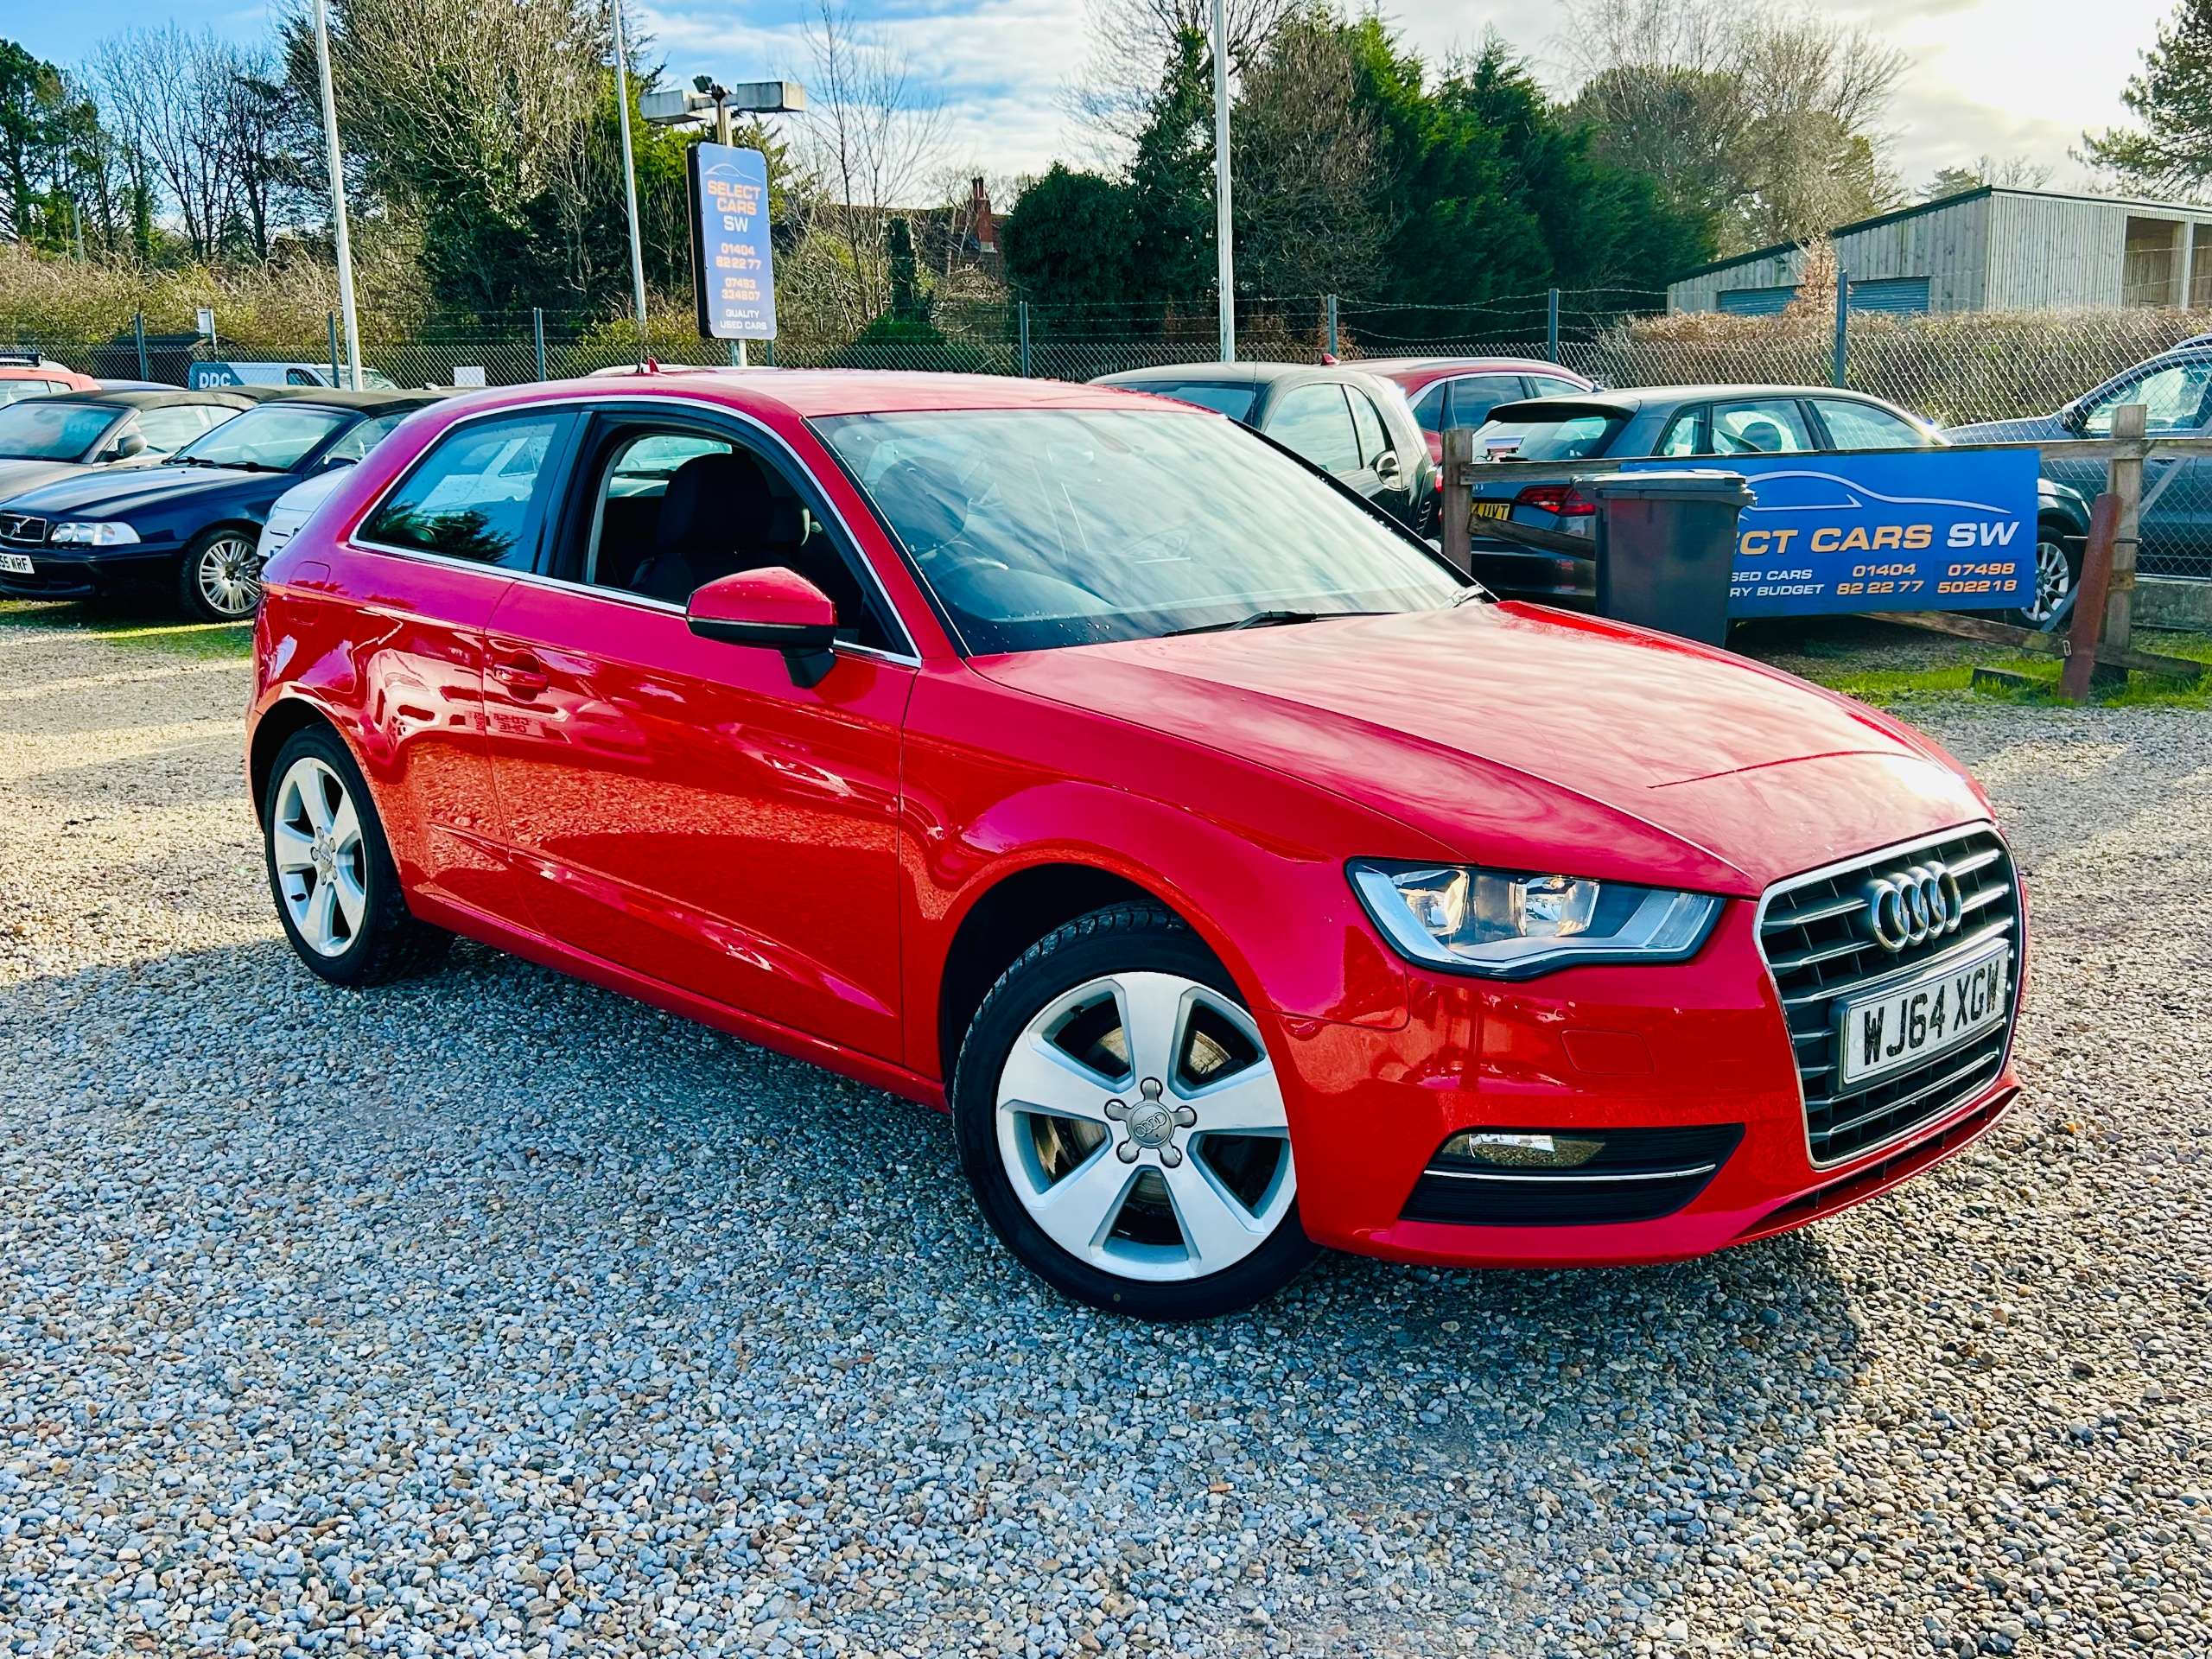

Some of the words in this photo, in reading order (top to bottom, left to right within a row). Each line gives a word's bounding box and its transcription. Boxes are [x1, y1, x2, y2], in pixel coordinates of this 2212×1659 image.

[707, 180, 761, 200] SELECT
[716, 197, 757, 215] CARS
[723, 215, 748, 232] SW
[721, 242, 755, 256] 01404
[726, 308, 760, 321] QUALITY
[720, 320, 743, 330] USED
[744, 321, 767, 331] CARS
[1735, 529, 1798, 555] CT
[1810, 524, 1934, 552] CARS
[1947, 521, 2020, 548] SW
[1766, 569, 1813, 581] CARS
[1852, 563, 1917, 577] 01404
[1948, 563, 2016, 576] 07498
[1757, 584, 1825, 596] BUDGET
[1836, 582, 1864, 595] 82
[1866, 581, 1894, 594] 22
[1897, 580, 1925, 593] 77
[1937, 580, 2018, 594] 502218
[1864, 984, 1946, 1066] WJ64
[1953, 959, 1999, 1032] XGW
